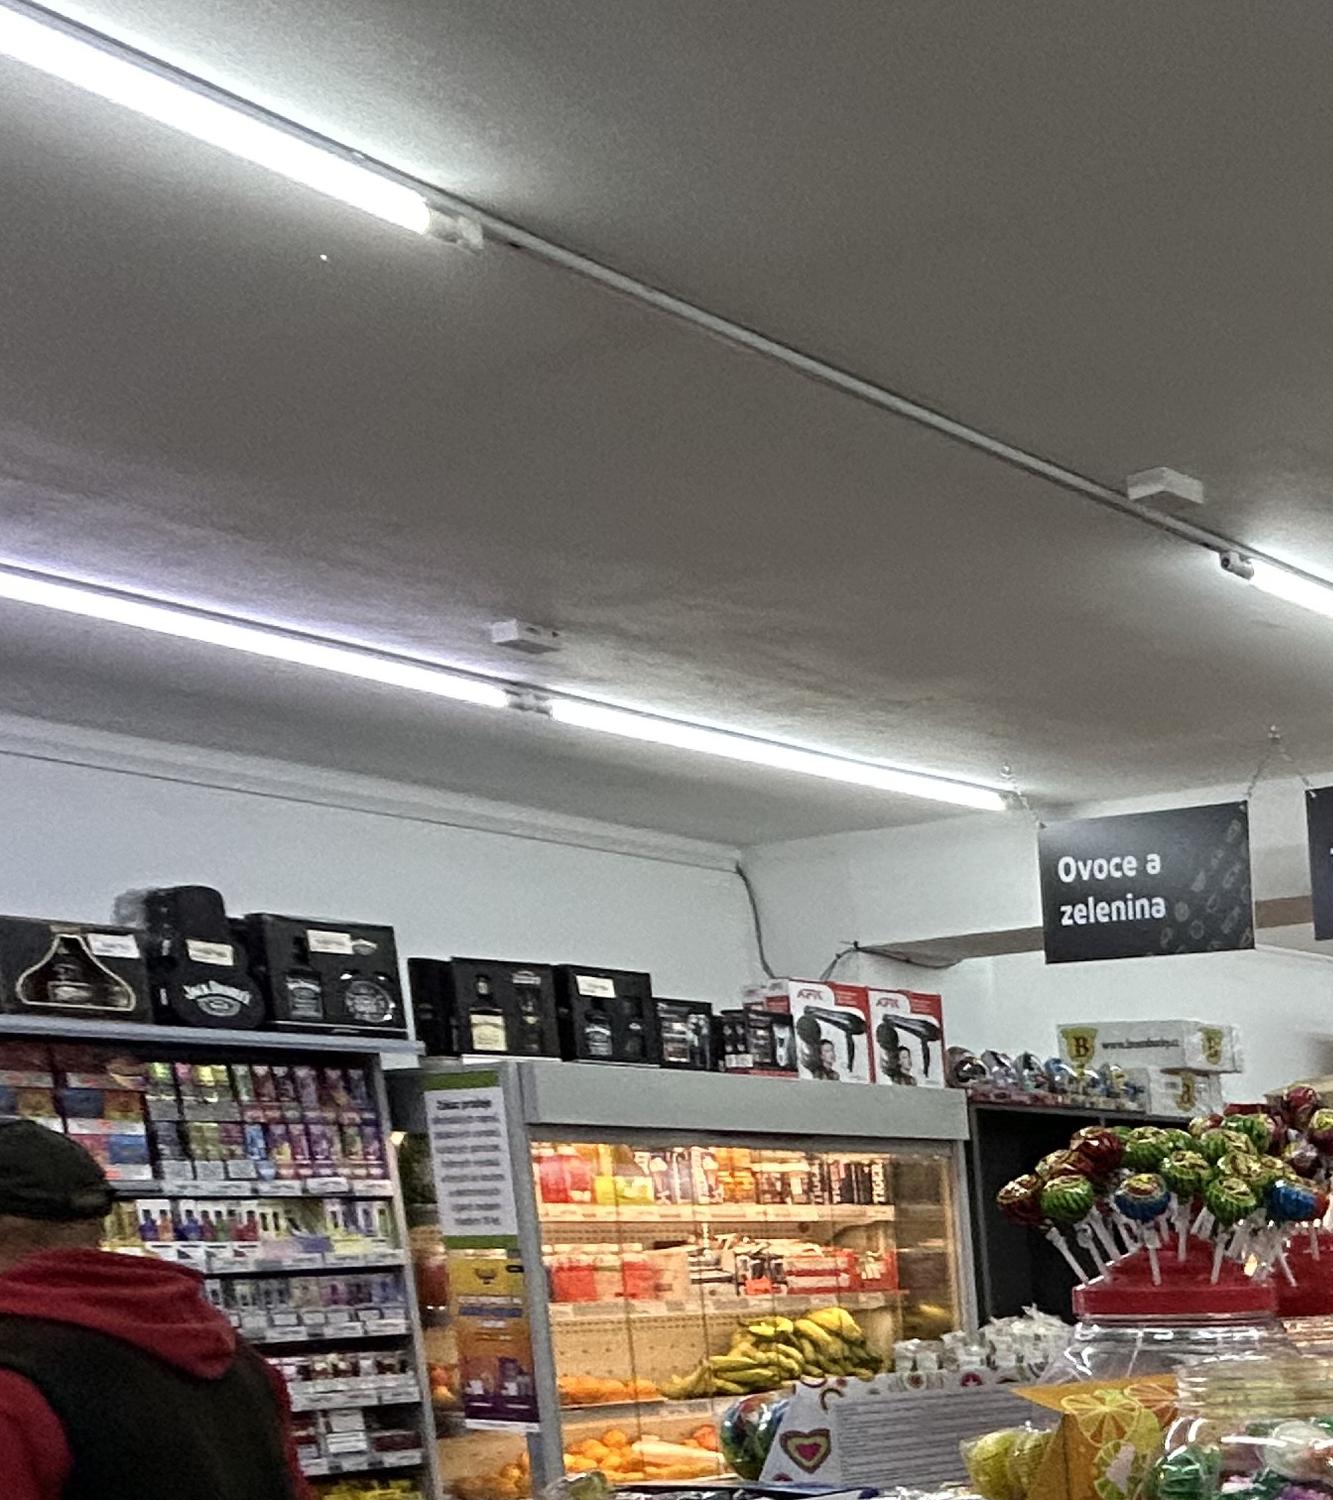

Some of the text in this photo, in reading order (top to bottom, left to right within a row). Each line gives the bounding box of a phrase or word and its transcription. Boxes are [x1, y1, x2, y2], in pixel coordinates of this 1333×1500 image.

[1057, 854, 1162, 884] Ovoce a
[1060, 894, 1166, 926] zelenina
